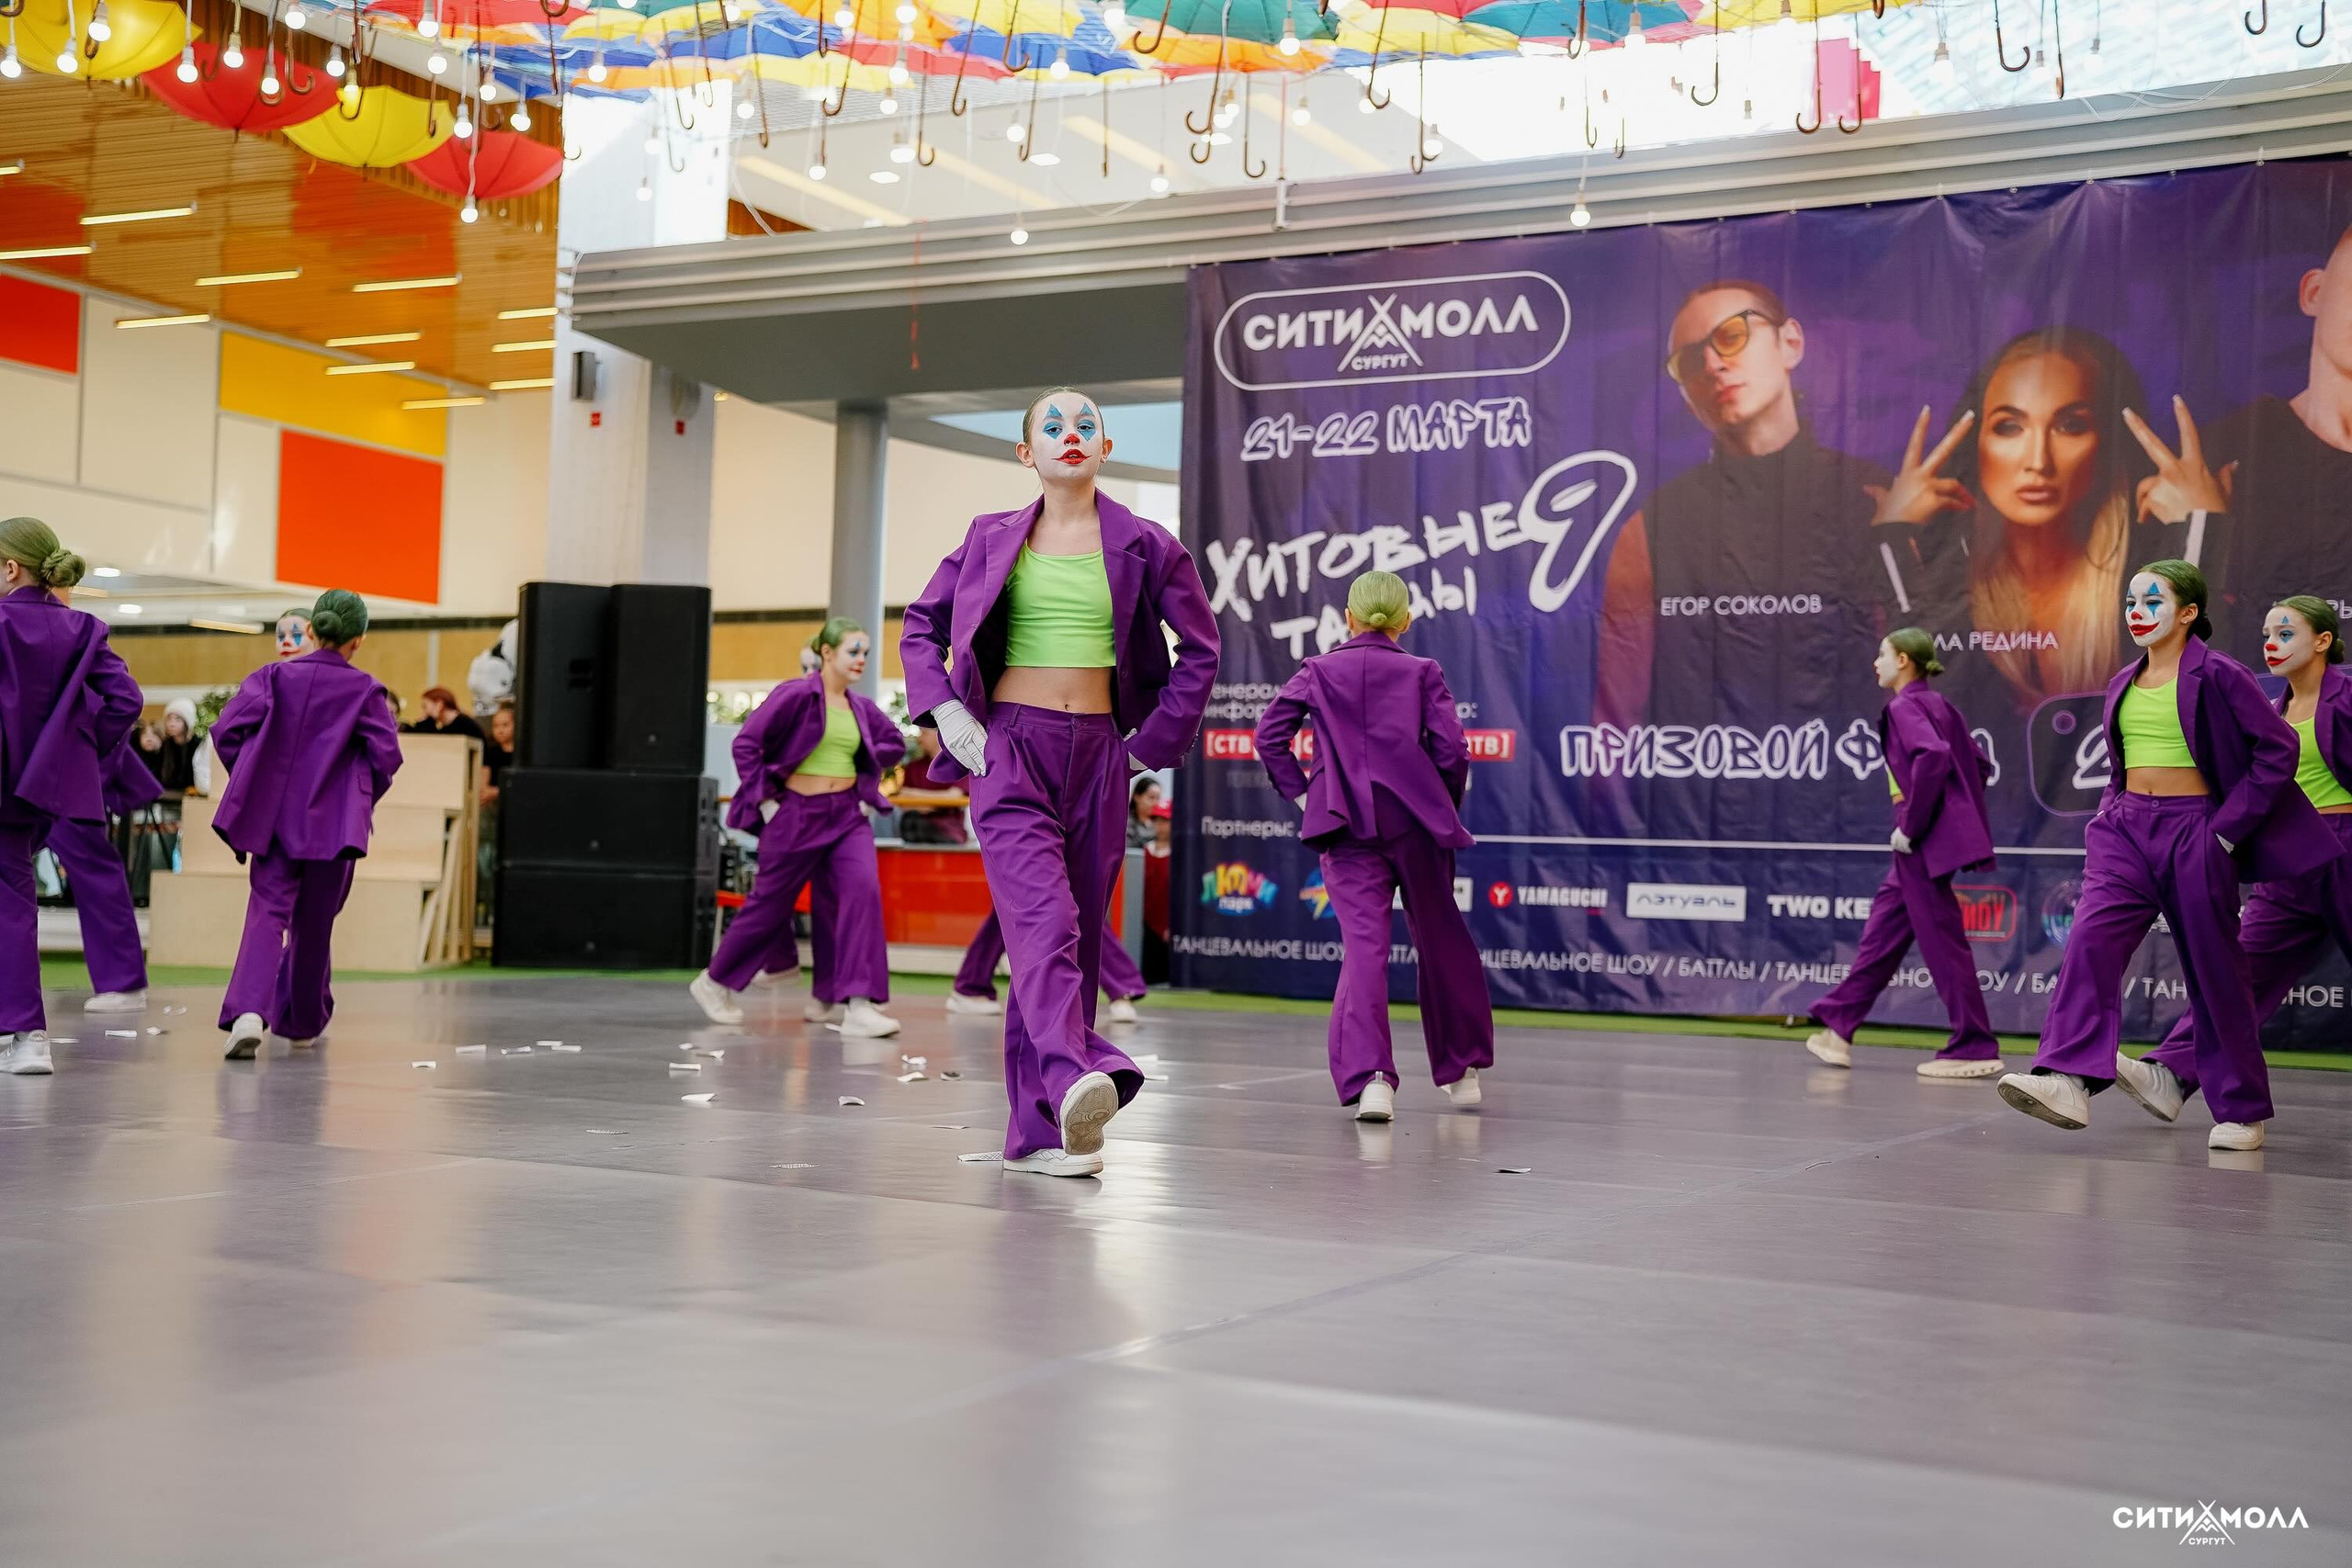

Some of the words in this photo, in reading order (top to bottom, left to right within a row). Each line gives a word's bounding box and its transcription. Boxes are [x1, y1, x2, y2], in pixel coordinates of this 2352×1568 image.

[1351, 352, 1409, 372] СУРГУТ
[1240, 410, 1380, 462] 21-22
[1386, 396, 1533, 453] МАРТА
[1204, 502, 1530, 622] ХИТОВЫЕ
[1660, 596, 1712, 616] ЕГОР
[1714, 593, 1823, 616] СОКОЛОВ
[1969, 630, 2059, 653] РЕДИНА
[1560, 717, 1830, 781] ПРИЗОВОЙ
[1517, 886, 1607, 908] YAMAGUCHI
[1767, 895, 1829, 919] TWO
[1608, 953, 1660, 976] ШОУ
[1679, 956, 1757, 980] БАТТЛЫ
